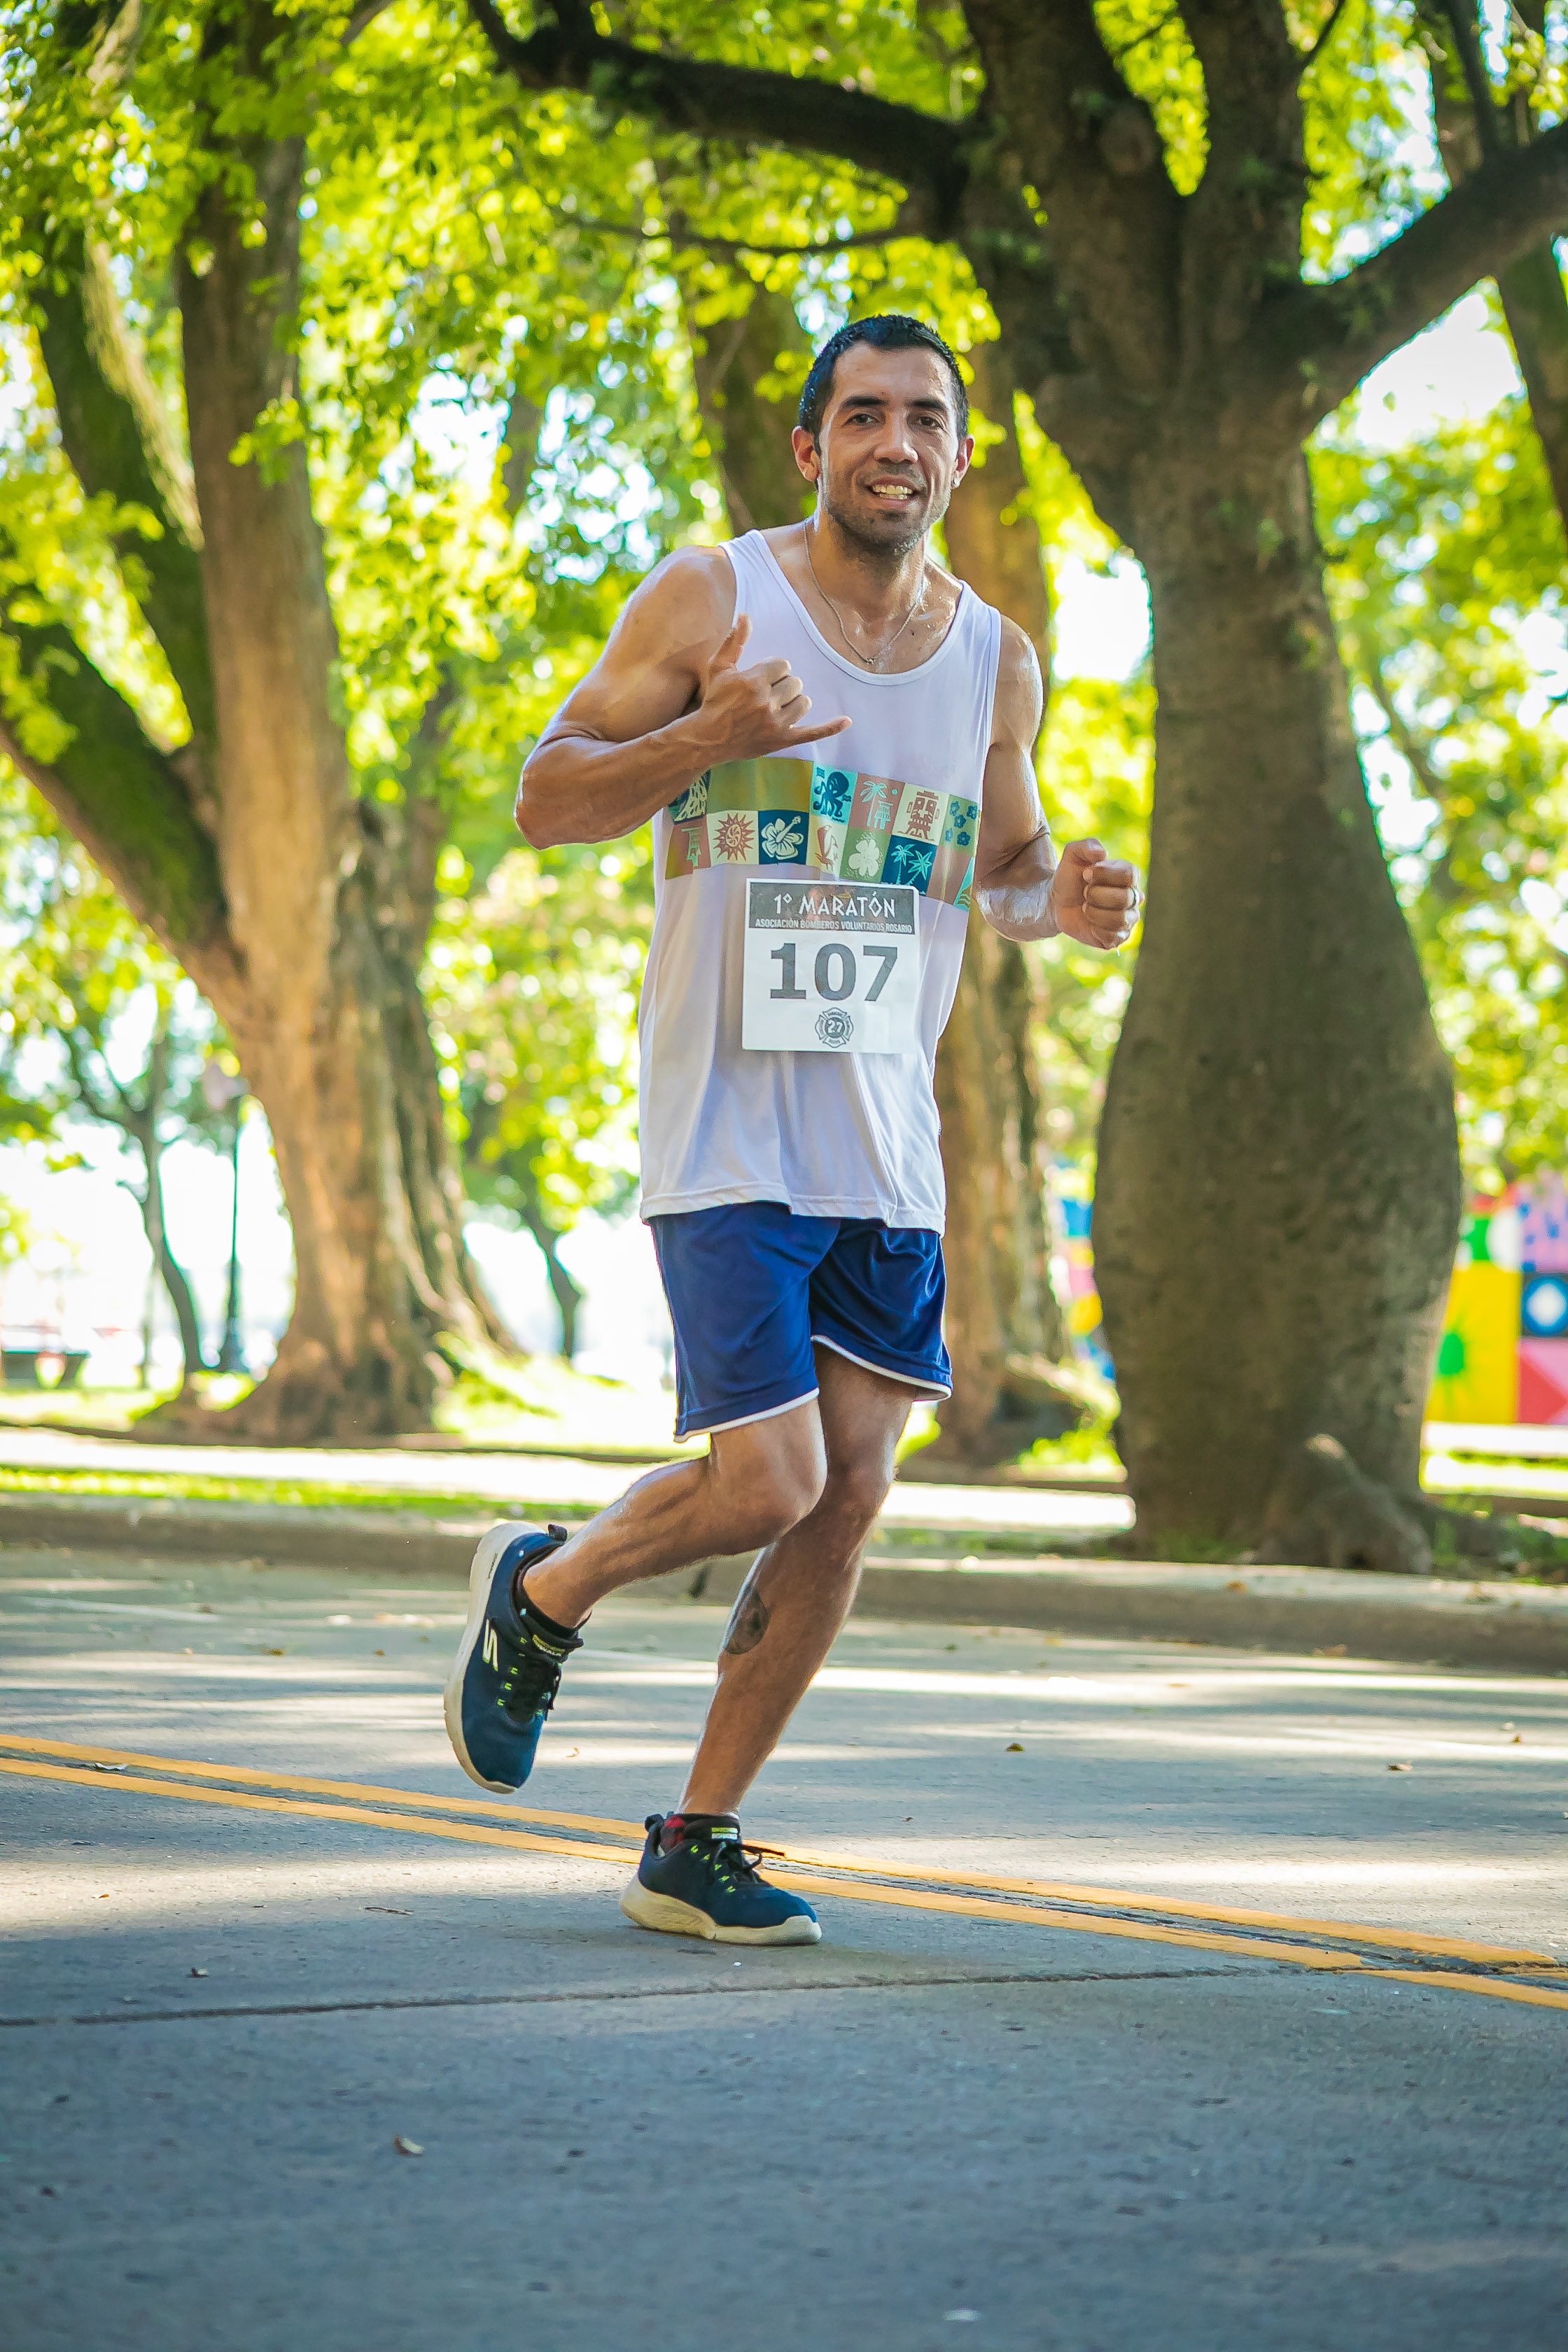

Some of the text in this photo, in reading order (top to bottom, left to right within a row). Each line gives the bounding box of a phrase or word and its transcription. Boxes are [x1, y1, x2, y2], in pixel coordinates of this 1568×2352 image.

[755, 918, 913, 934] ASOCIACIÓN BOMBEROS VOLUNTARIOS ROSARIO
[770, 942, 898, 1002] 107
[827, 1018, 844, 1034] 27
